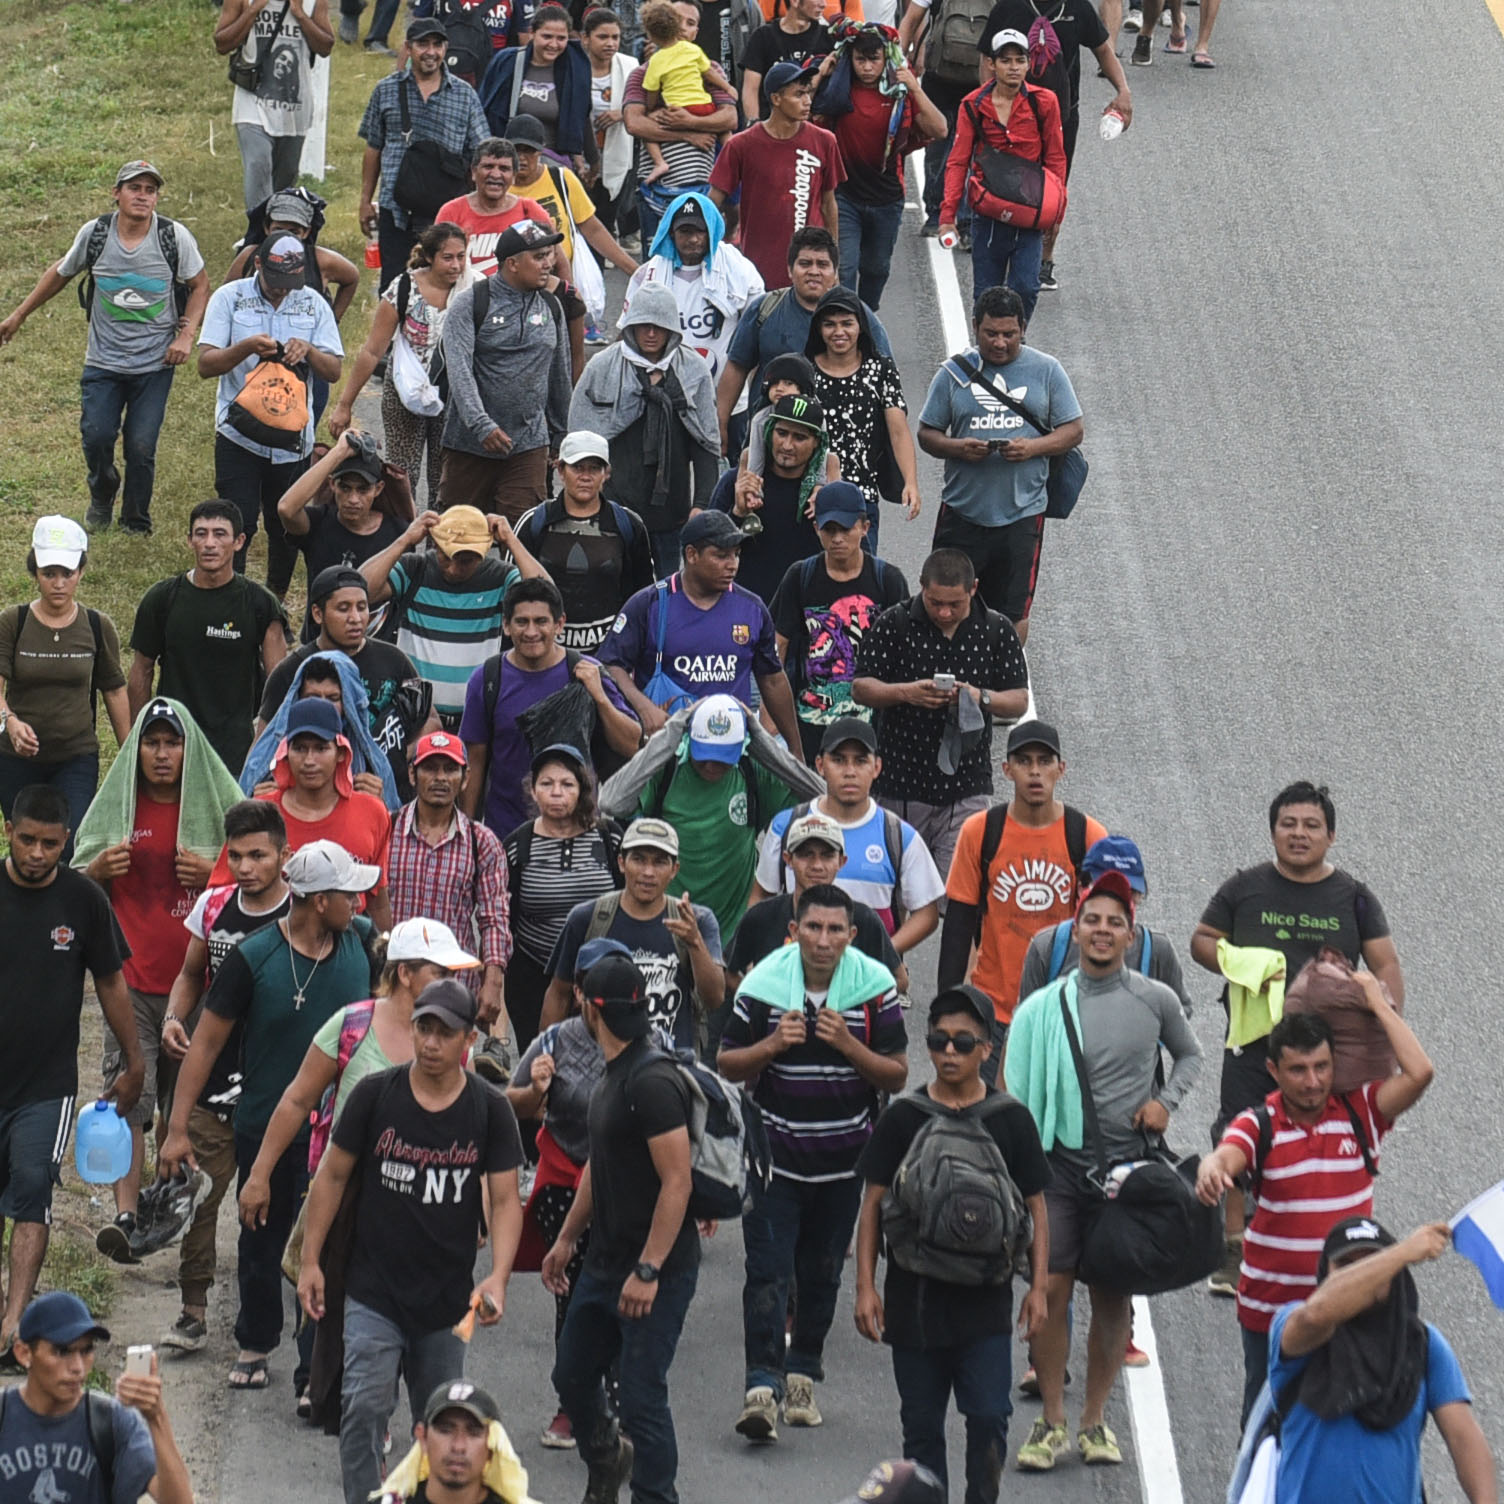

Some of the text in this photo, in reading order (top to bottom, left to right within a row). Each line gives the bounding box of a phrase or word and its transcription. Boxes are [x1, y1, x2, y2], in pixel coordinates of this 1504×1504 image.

[254, 23, 302, 38] MARLE
[679, 311, 714, 331] igo
[970, 413, 1025, 430] adidas
[206, 626, 242, 639] Hastings
[673, 654, 738, 676] QATAR
[689, 670, 736, 683] AIRWAYS
[992, 859, 1071, 905] UNLIMITED
[1261, 911, 1341, 931] Nice SaaS
[422, 1167, 471, 1204] NY
